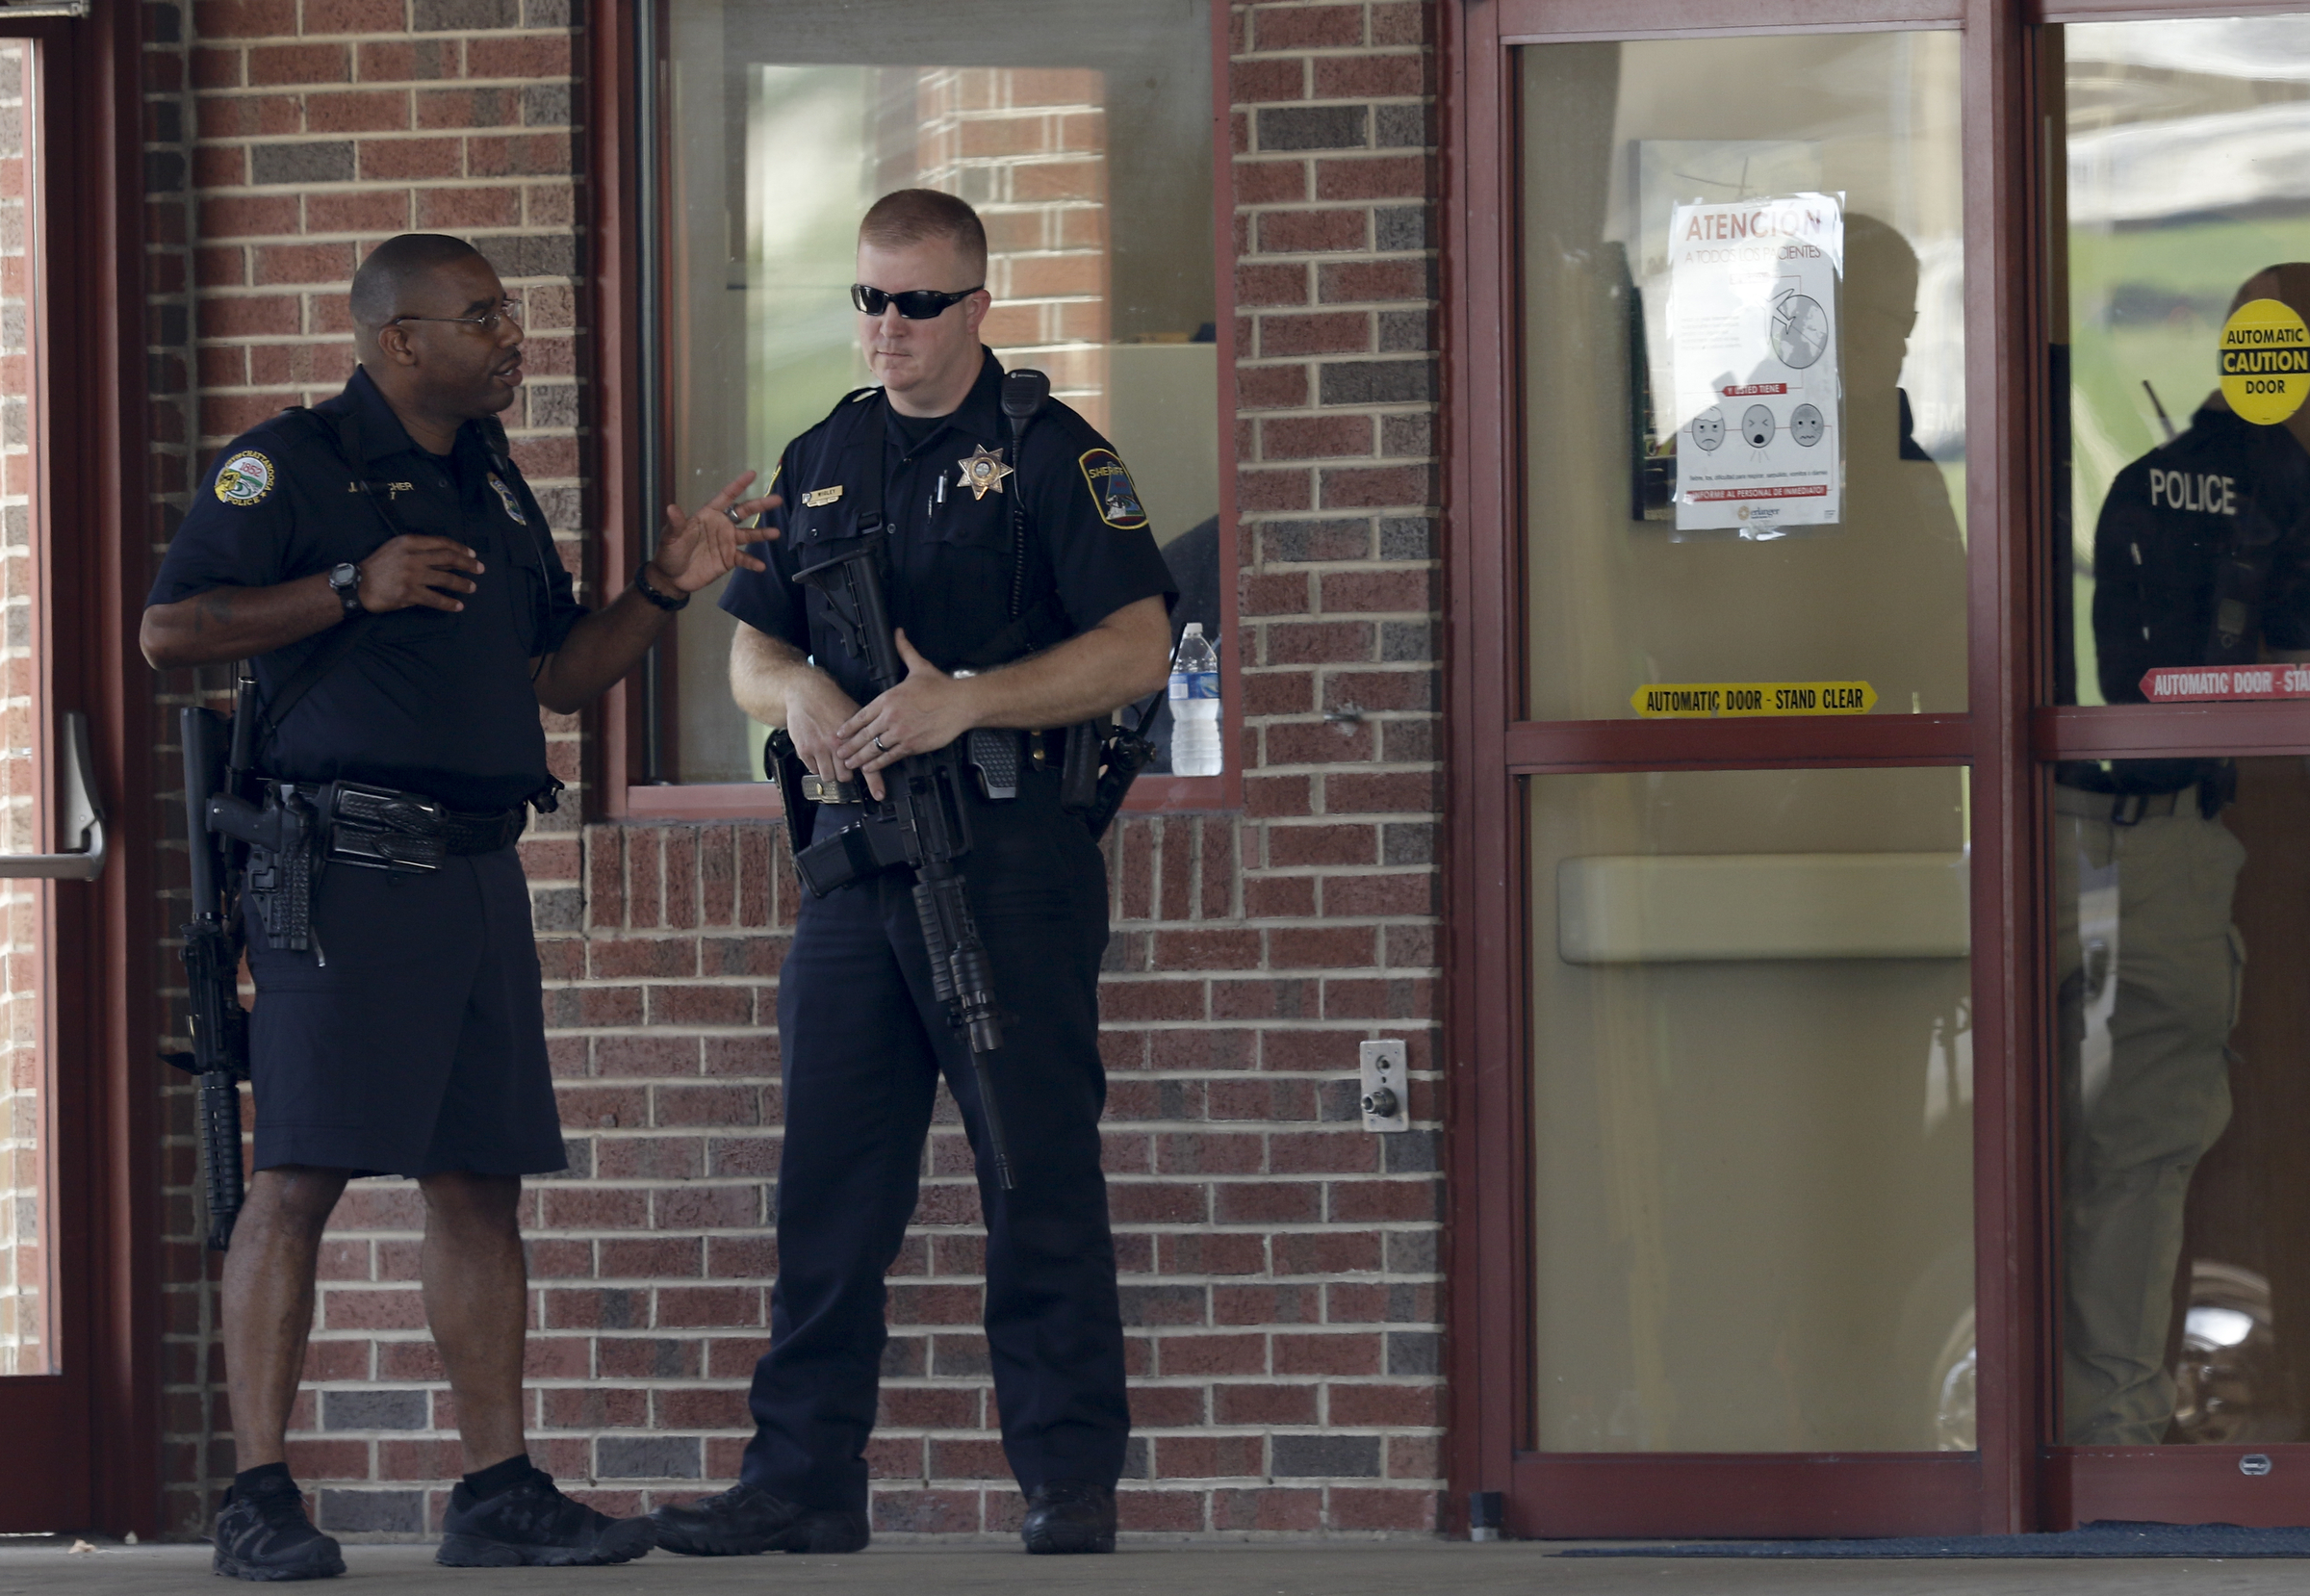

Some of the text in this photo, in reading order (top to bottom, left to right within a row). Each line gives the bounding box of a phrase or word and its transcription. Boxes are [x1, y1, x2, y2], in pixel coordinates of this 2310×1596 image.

[1685, 204, 1821, 241] ATENCIÓN
[1684, 245, 1821, 264] A TODOS LOS PACIENTES
[2226, 328, 2303, 345] AUTOMATIC
[2223, 350, 2308, 373] CAUTION
[1734, 385, 1758, 395] USTED
[1759, 384, 1780, 394] TIENE
[2246, 379, 2285, 395] DOOR
[240, 461, 263, 477] 1852
[1089, 466, 1124, 478] SHERIFF
[1736, 488, 1771, 498] PERSONAL
[2149, 468, 2237, 515] POLICE
[227, 496, 261, 506] POLICE
[2154, 672, 2229, 696] AUTOMATIC
[2233, 671, 2272, 693] DOOR
[1647, 690, 1720, 711] AUTOMATIC
[1726, 689, 1762, 710] DOOR
[1776, 689, 1815, 709] STAND
[1823, 688, 1863, 708] CLEAR
